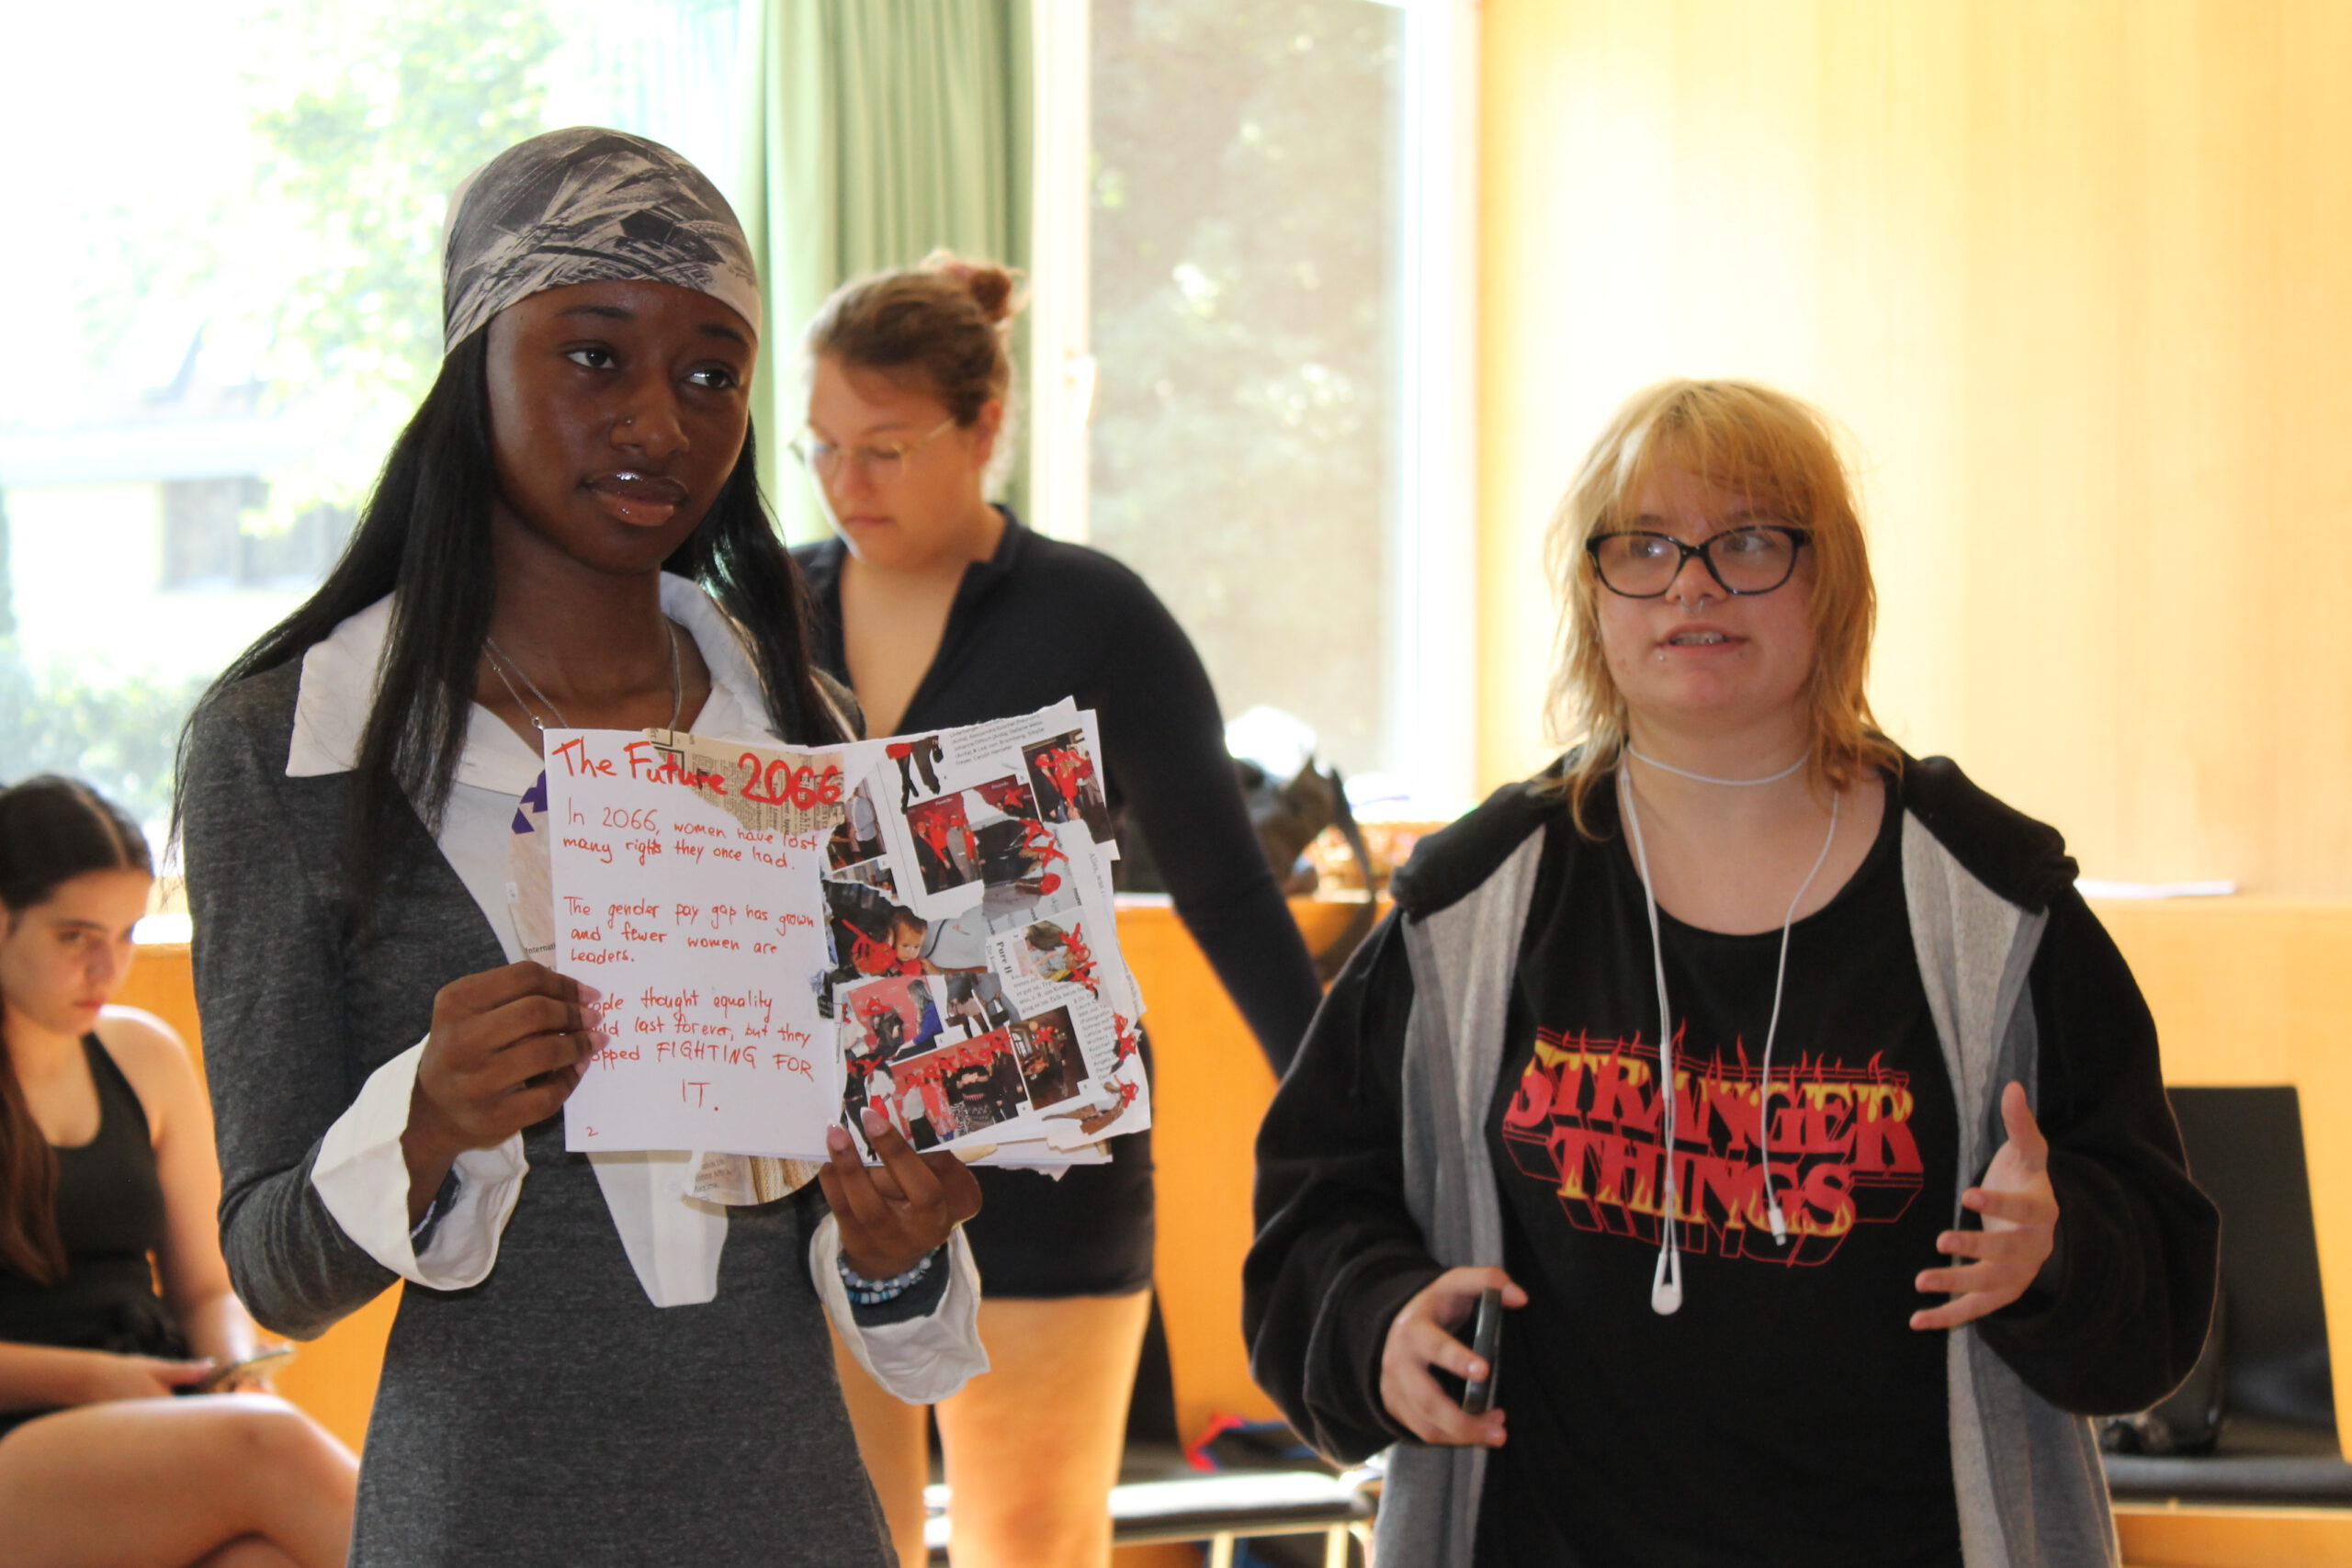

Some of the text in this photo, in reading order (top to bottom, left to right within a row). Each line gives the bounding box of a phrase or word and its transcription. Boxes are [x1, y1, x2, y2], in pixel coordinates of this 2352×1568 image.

[551, 736, 617, 778] The
[623, 740, 729, 795] Future
[737, 752, 842, 811] 2066
[568, 796, 818, 852] In 2066, women have lost
[562, 837, 613, 863] many
[673, 839, 705, 865] they
[713, 847, 742, 862] once
[752, 846, 796, 871] had.
[562, 896, 814, 936] The gender pay gap has grown
[571, 920, 777, 954] and fewer women are
[591, 986, 773, 1023] ople thought equality
[635, 1016, 665, 1034] last
[745, 1022, 768, 1039] but
[776, 1022, 811, 1049] they
[590, 1040, 814, 1082] opped FIGHTING FOR
[682, 1078, 718, 1111] IT.
[1502, 1029, 1924, 1176] STRANGER
[585, 1126, 598, 1137] 2
[1546, 1126, 1858, 1240] THINGS
